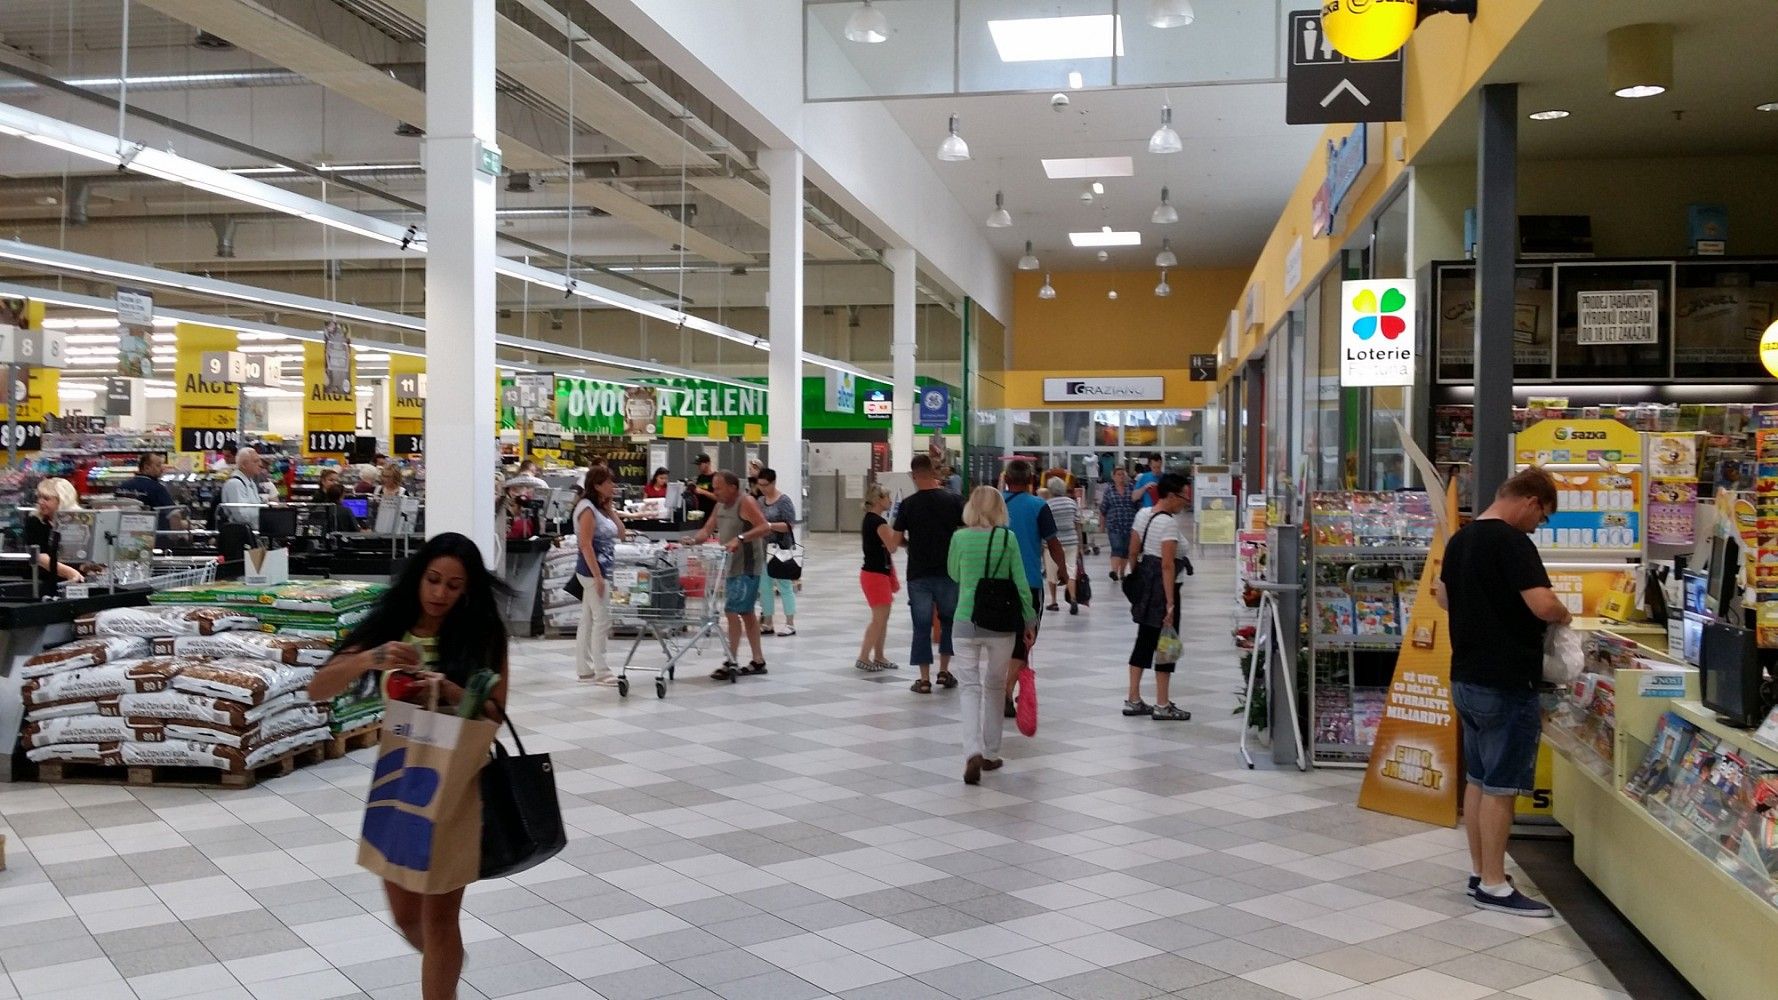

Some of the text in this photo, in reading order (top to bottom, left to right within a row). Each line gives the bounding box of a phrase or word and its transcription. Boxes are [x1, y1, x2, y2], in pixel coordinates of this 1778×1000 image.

[22, 339, 33, 356] 8
[1347, 347, 1411, 360] Loterie
[209, 358, 221, 374] 9
[400, 378, 415, 392] 11
[505, 391, 518, 402] 13
[1386, 705, 1452, 727] MILIARDY?
